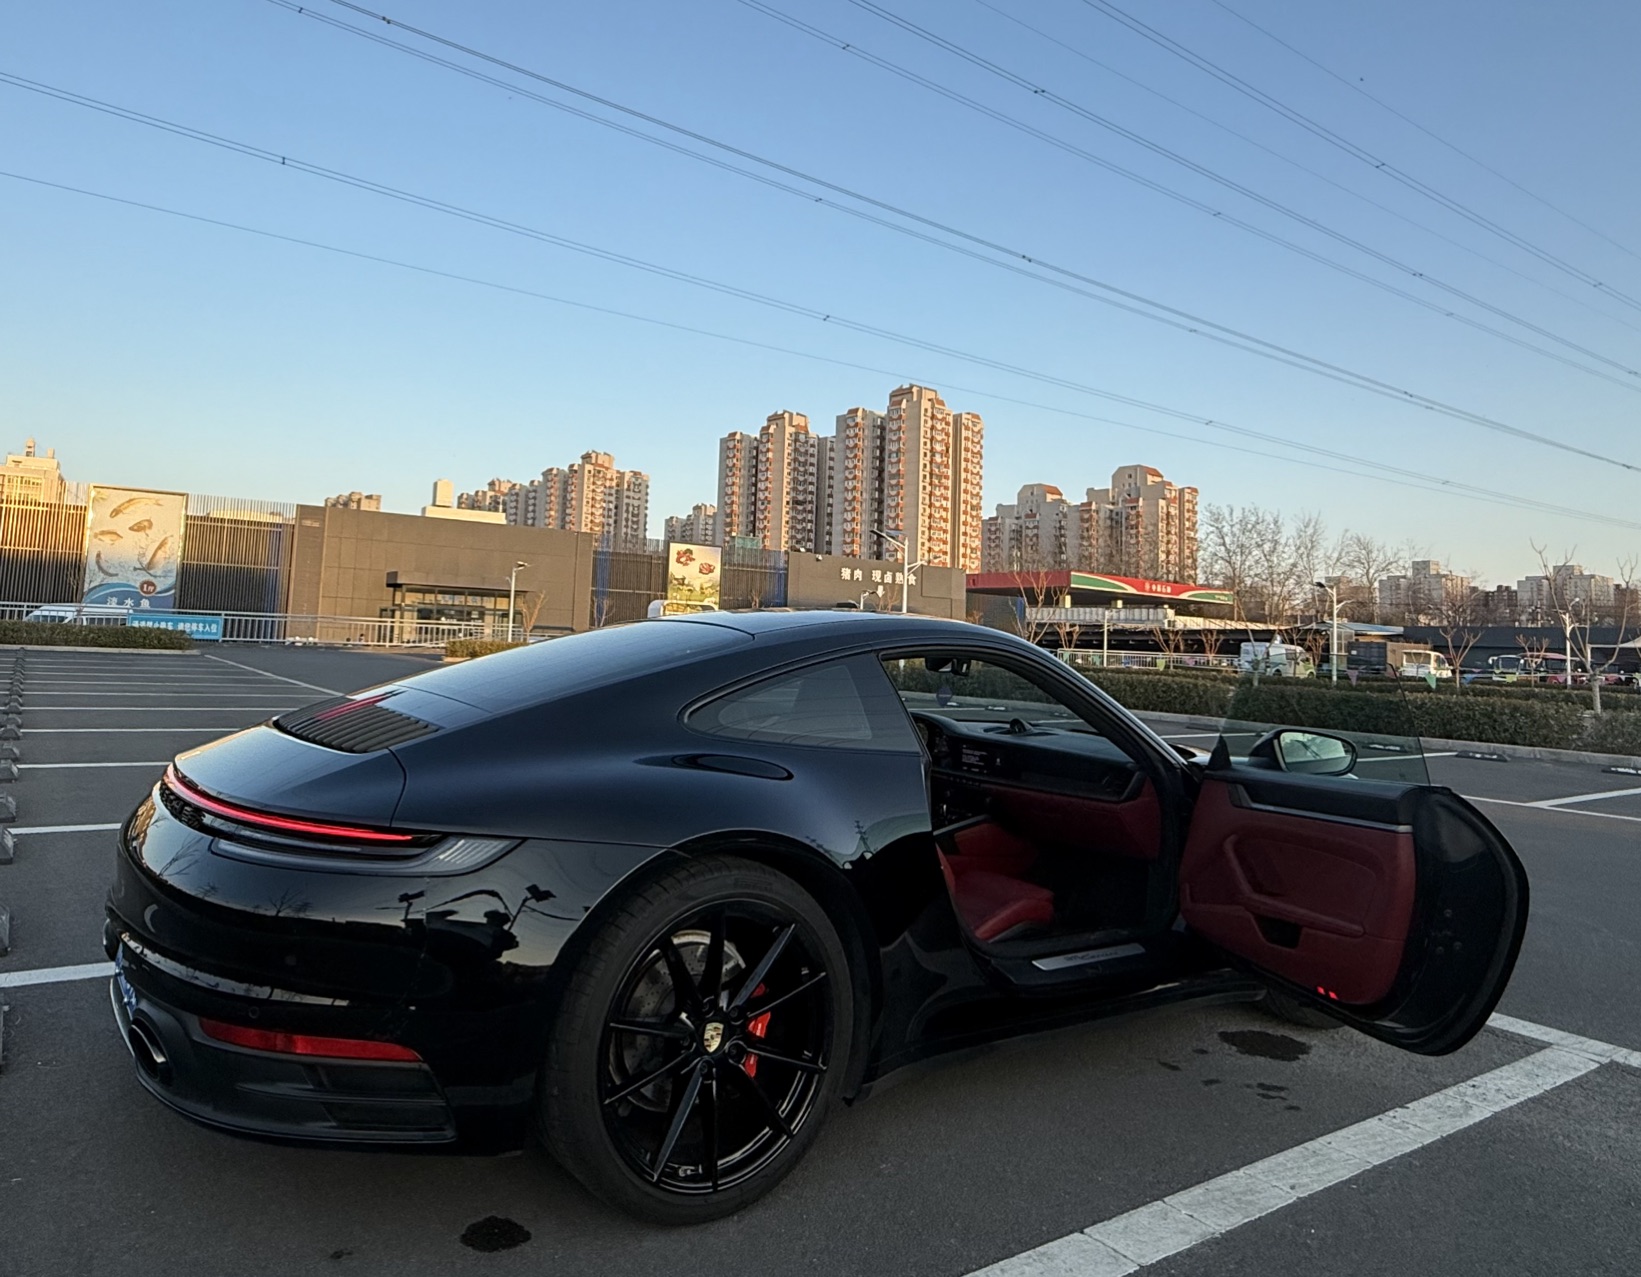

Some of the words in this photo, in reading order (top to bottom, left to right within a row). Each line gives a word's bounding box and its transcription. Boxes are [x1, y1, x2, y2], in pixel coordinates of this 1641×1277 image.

[841, 567, 863, 582] 猪肉
[872, 569, 917, 586] 现卤熟食
